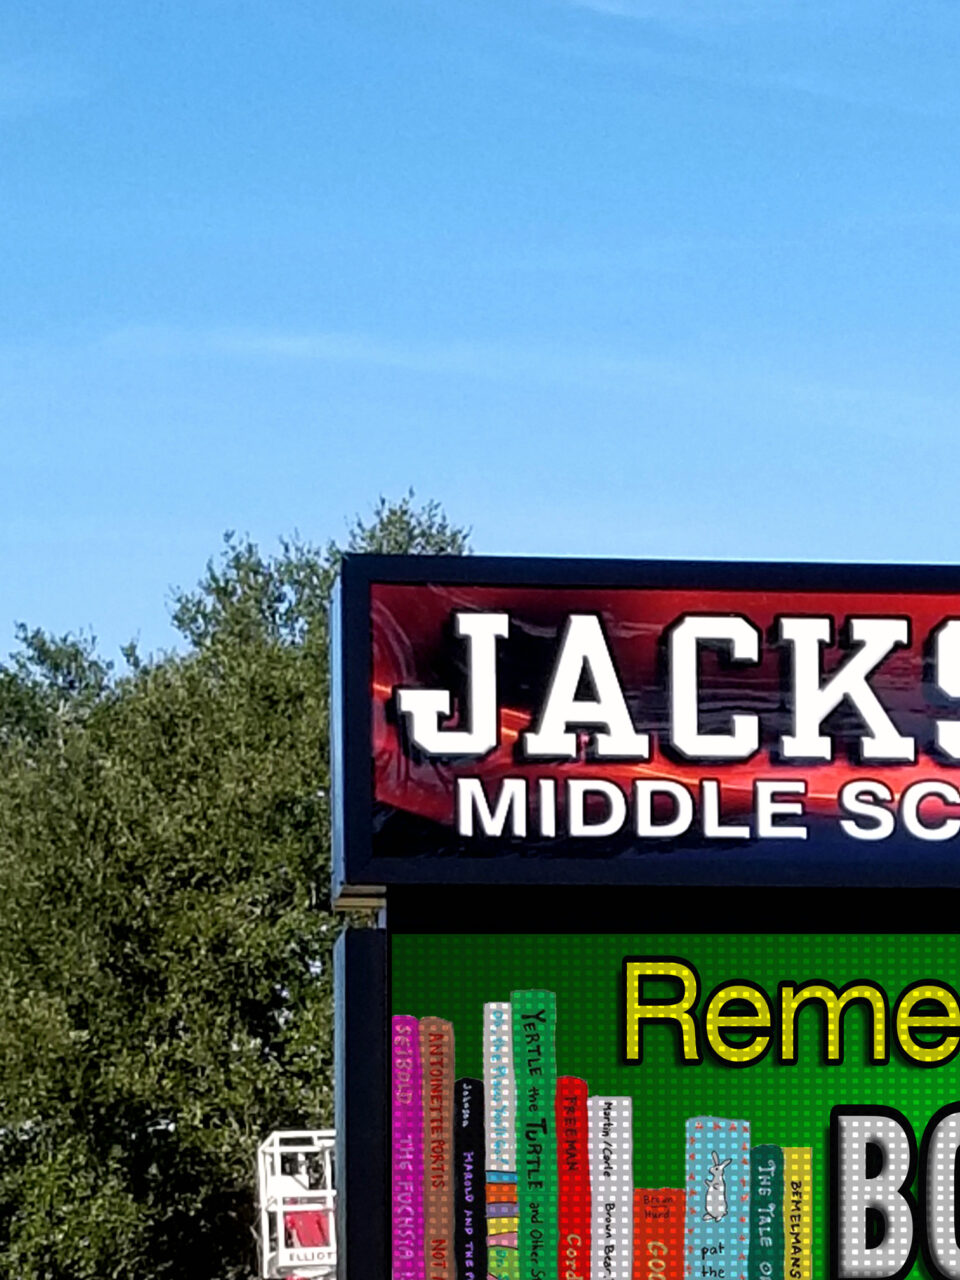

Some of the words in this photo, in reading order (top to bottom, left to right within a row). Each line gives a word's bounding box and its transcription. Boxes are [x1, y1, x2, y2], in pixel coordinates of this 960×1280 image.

[458, 777, 809, 842] MIDDLE
[522, 1009, 546, 1077] YERTLE
[428, 1032, 444, 1135] ANTOINETTE
[528, 1087, 542, 1112] the
[564, 1096, 578, 1172] FREEMAN
[602, 1102, 614, 1136] Martin
[430, 1139, 446, 1189] PORTIS
[525, 1118, 547, 1190] TURTLE
[463, 1152, 474, 1202] HAROLD
[758, 1160, 776, 1196] THE
[464, 1210, 473, 1235] AND
[530, 1202, 543, 1224] and
[604, 1203, 616, 1238] Brown
[758, 1203, 776, 1247] TALE
[789, 1180, 802, 1280] BEMELMANS
[432, 1239, 446, 1268] NOT
[465, 1241, 473, 1267] THE
[530, 1229, 543, 1263] Other
[701, 1243, 725, 1262] pat
[701, 1266, 726, 1279] the
